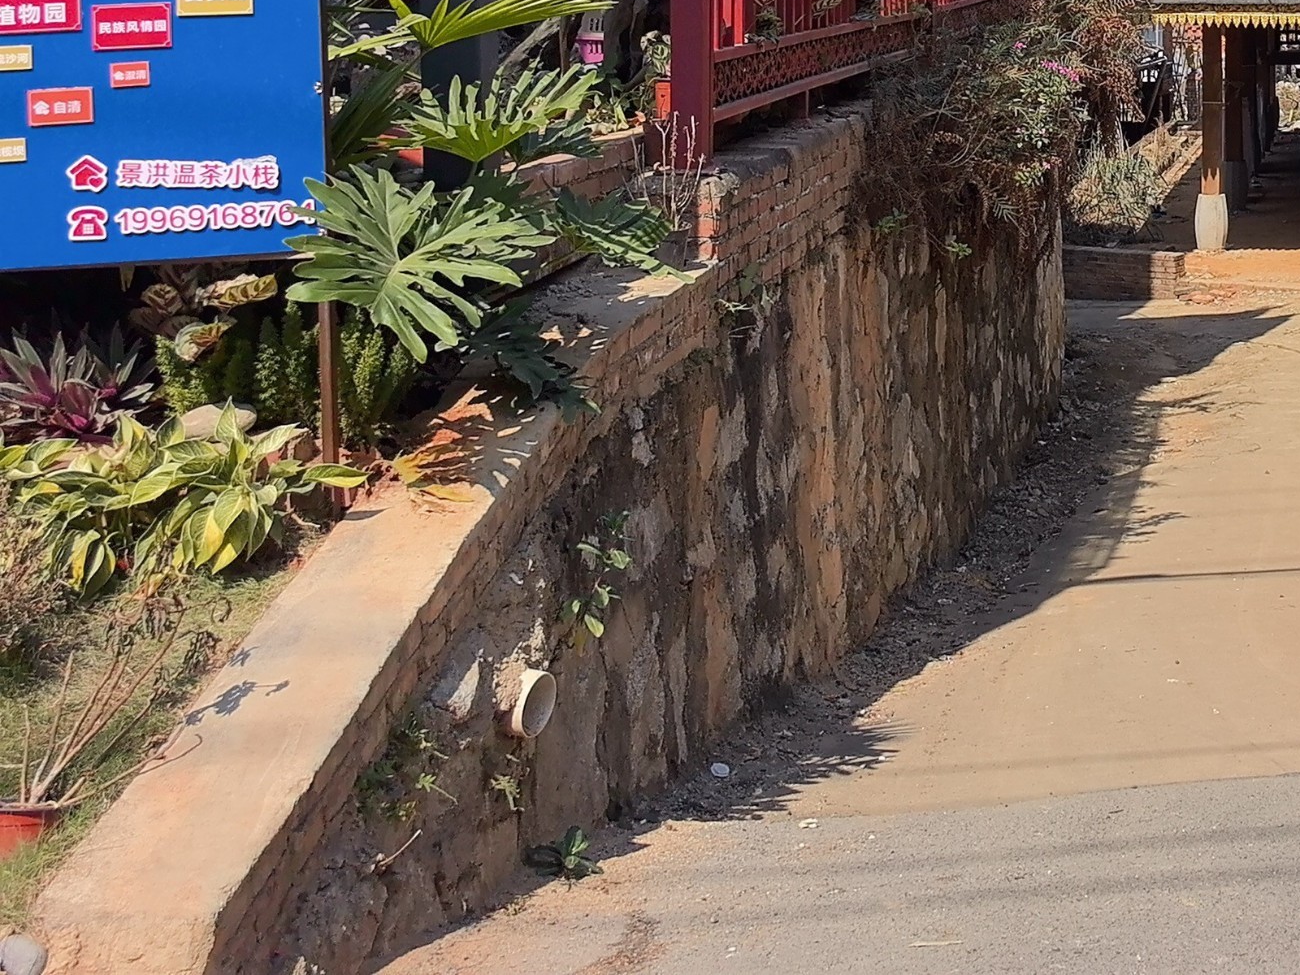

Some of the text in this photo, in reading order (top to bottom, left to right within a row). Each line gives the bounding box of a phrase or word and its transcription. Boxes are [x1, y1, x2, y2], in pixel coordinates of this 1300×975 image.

[0, 2, 67, 26] 植物园
[99, 19, 168, 35] 民族风情园
[118, 161, 278, 188] 景洪温茶小栈
